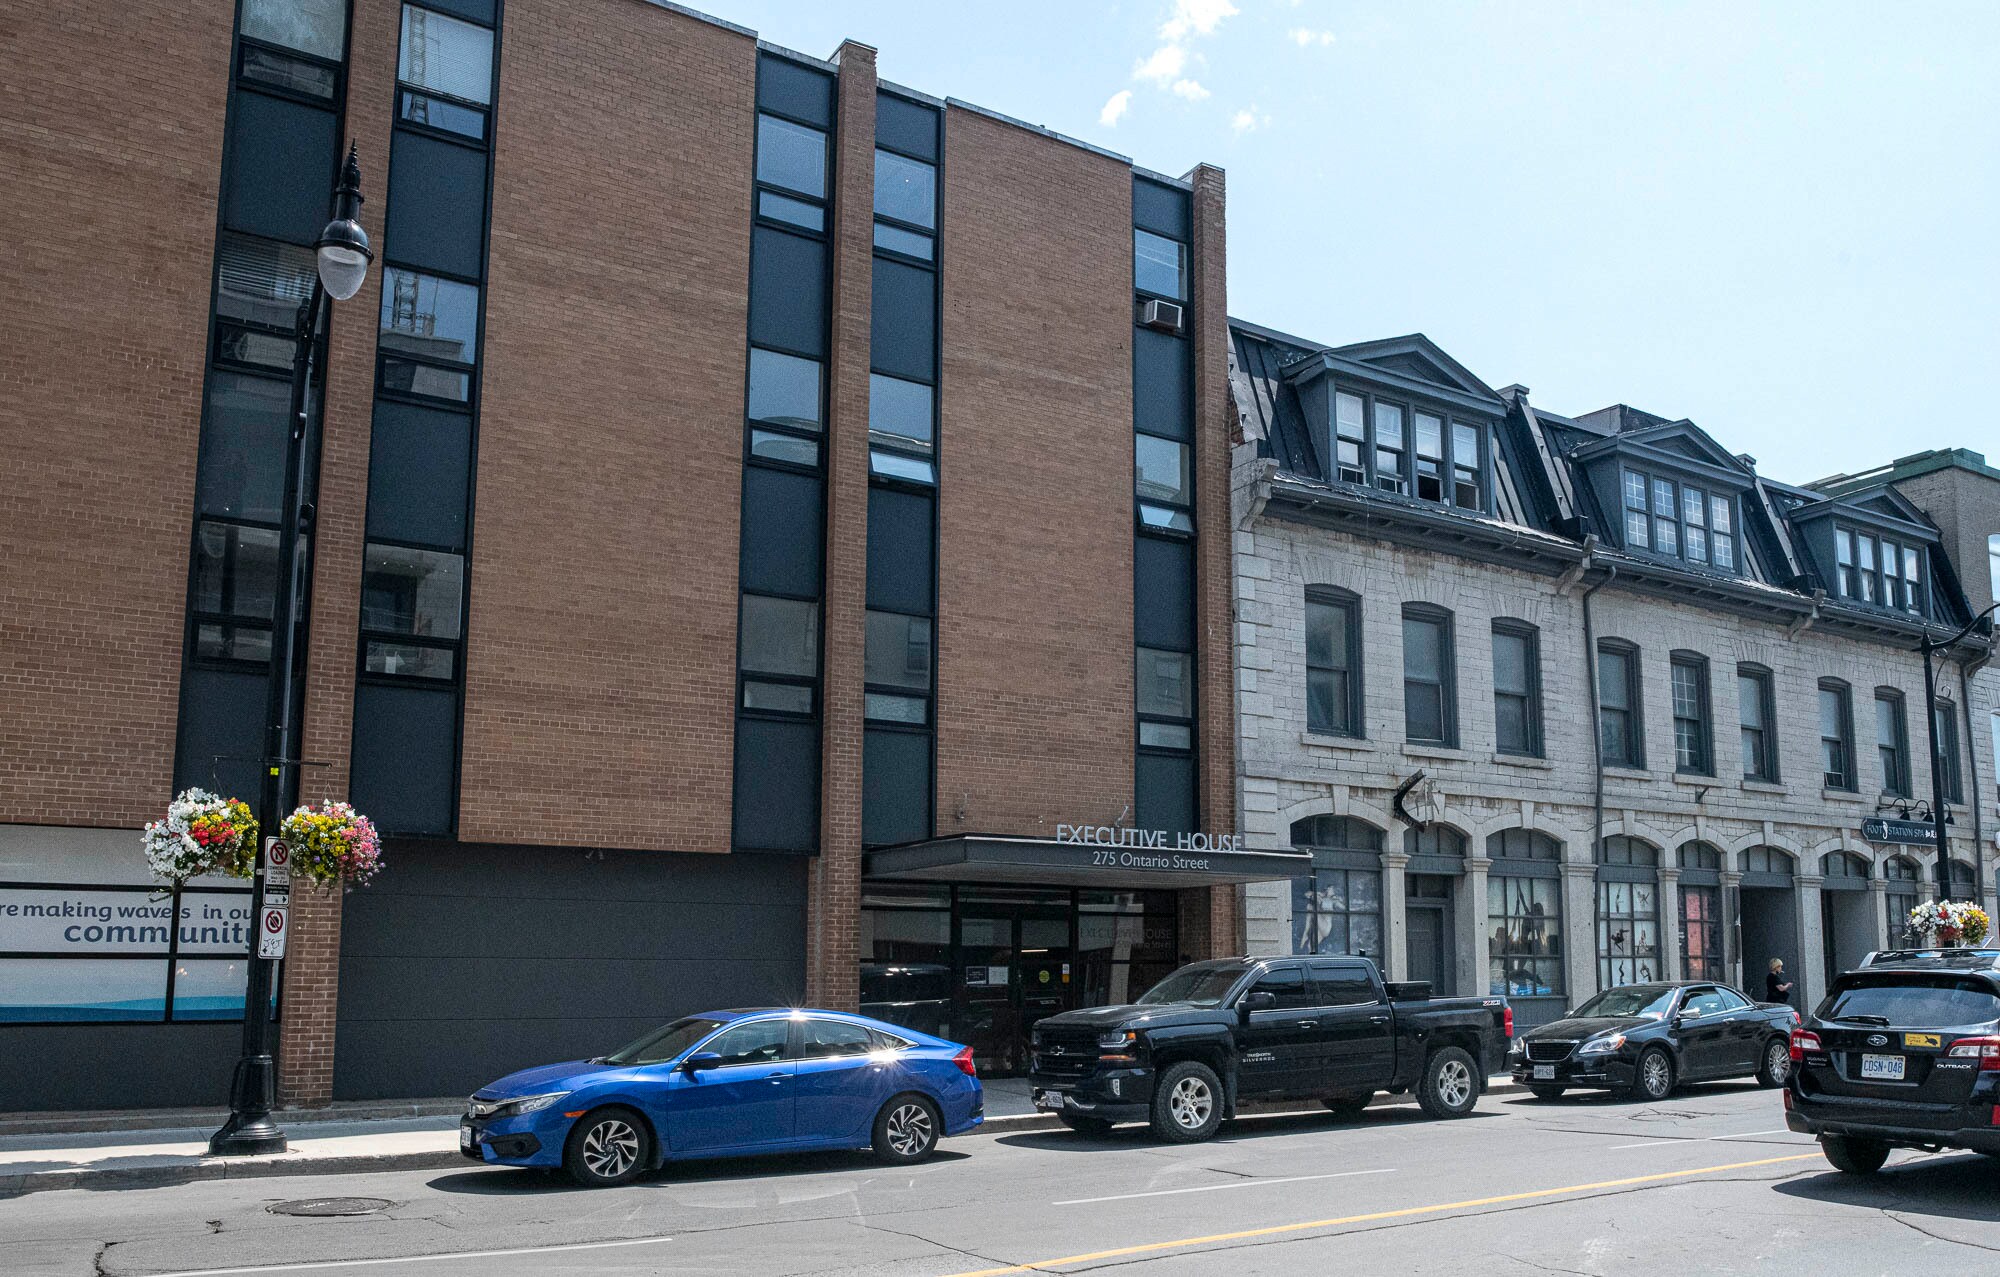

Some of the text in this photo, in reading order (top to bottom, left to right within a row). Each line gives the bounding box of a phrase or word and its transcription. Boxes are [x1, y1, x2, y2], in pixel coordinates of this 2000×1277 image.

[1056, 824, 1242, 851] EXECUTIVE HOUSE
[1866, 824, 1925, 838] FOOT STATION SPA
[1092, 851, 1209, 870] 275 Ontario Street
[23, 900, 112, 922] making
[203, 903, 222, 919] in
[229, 908, 251, 920] ou
